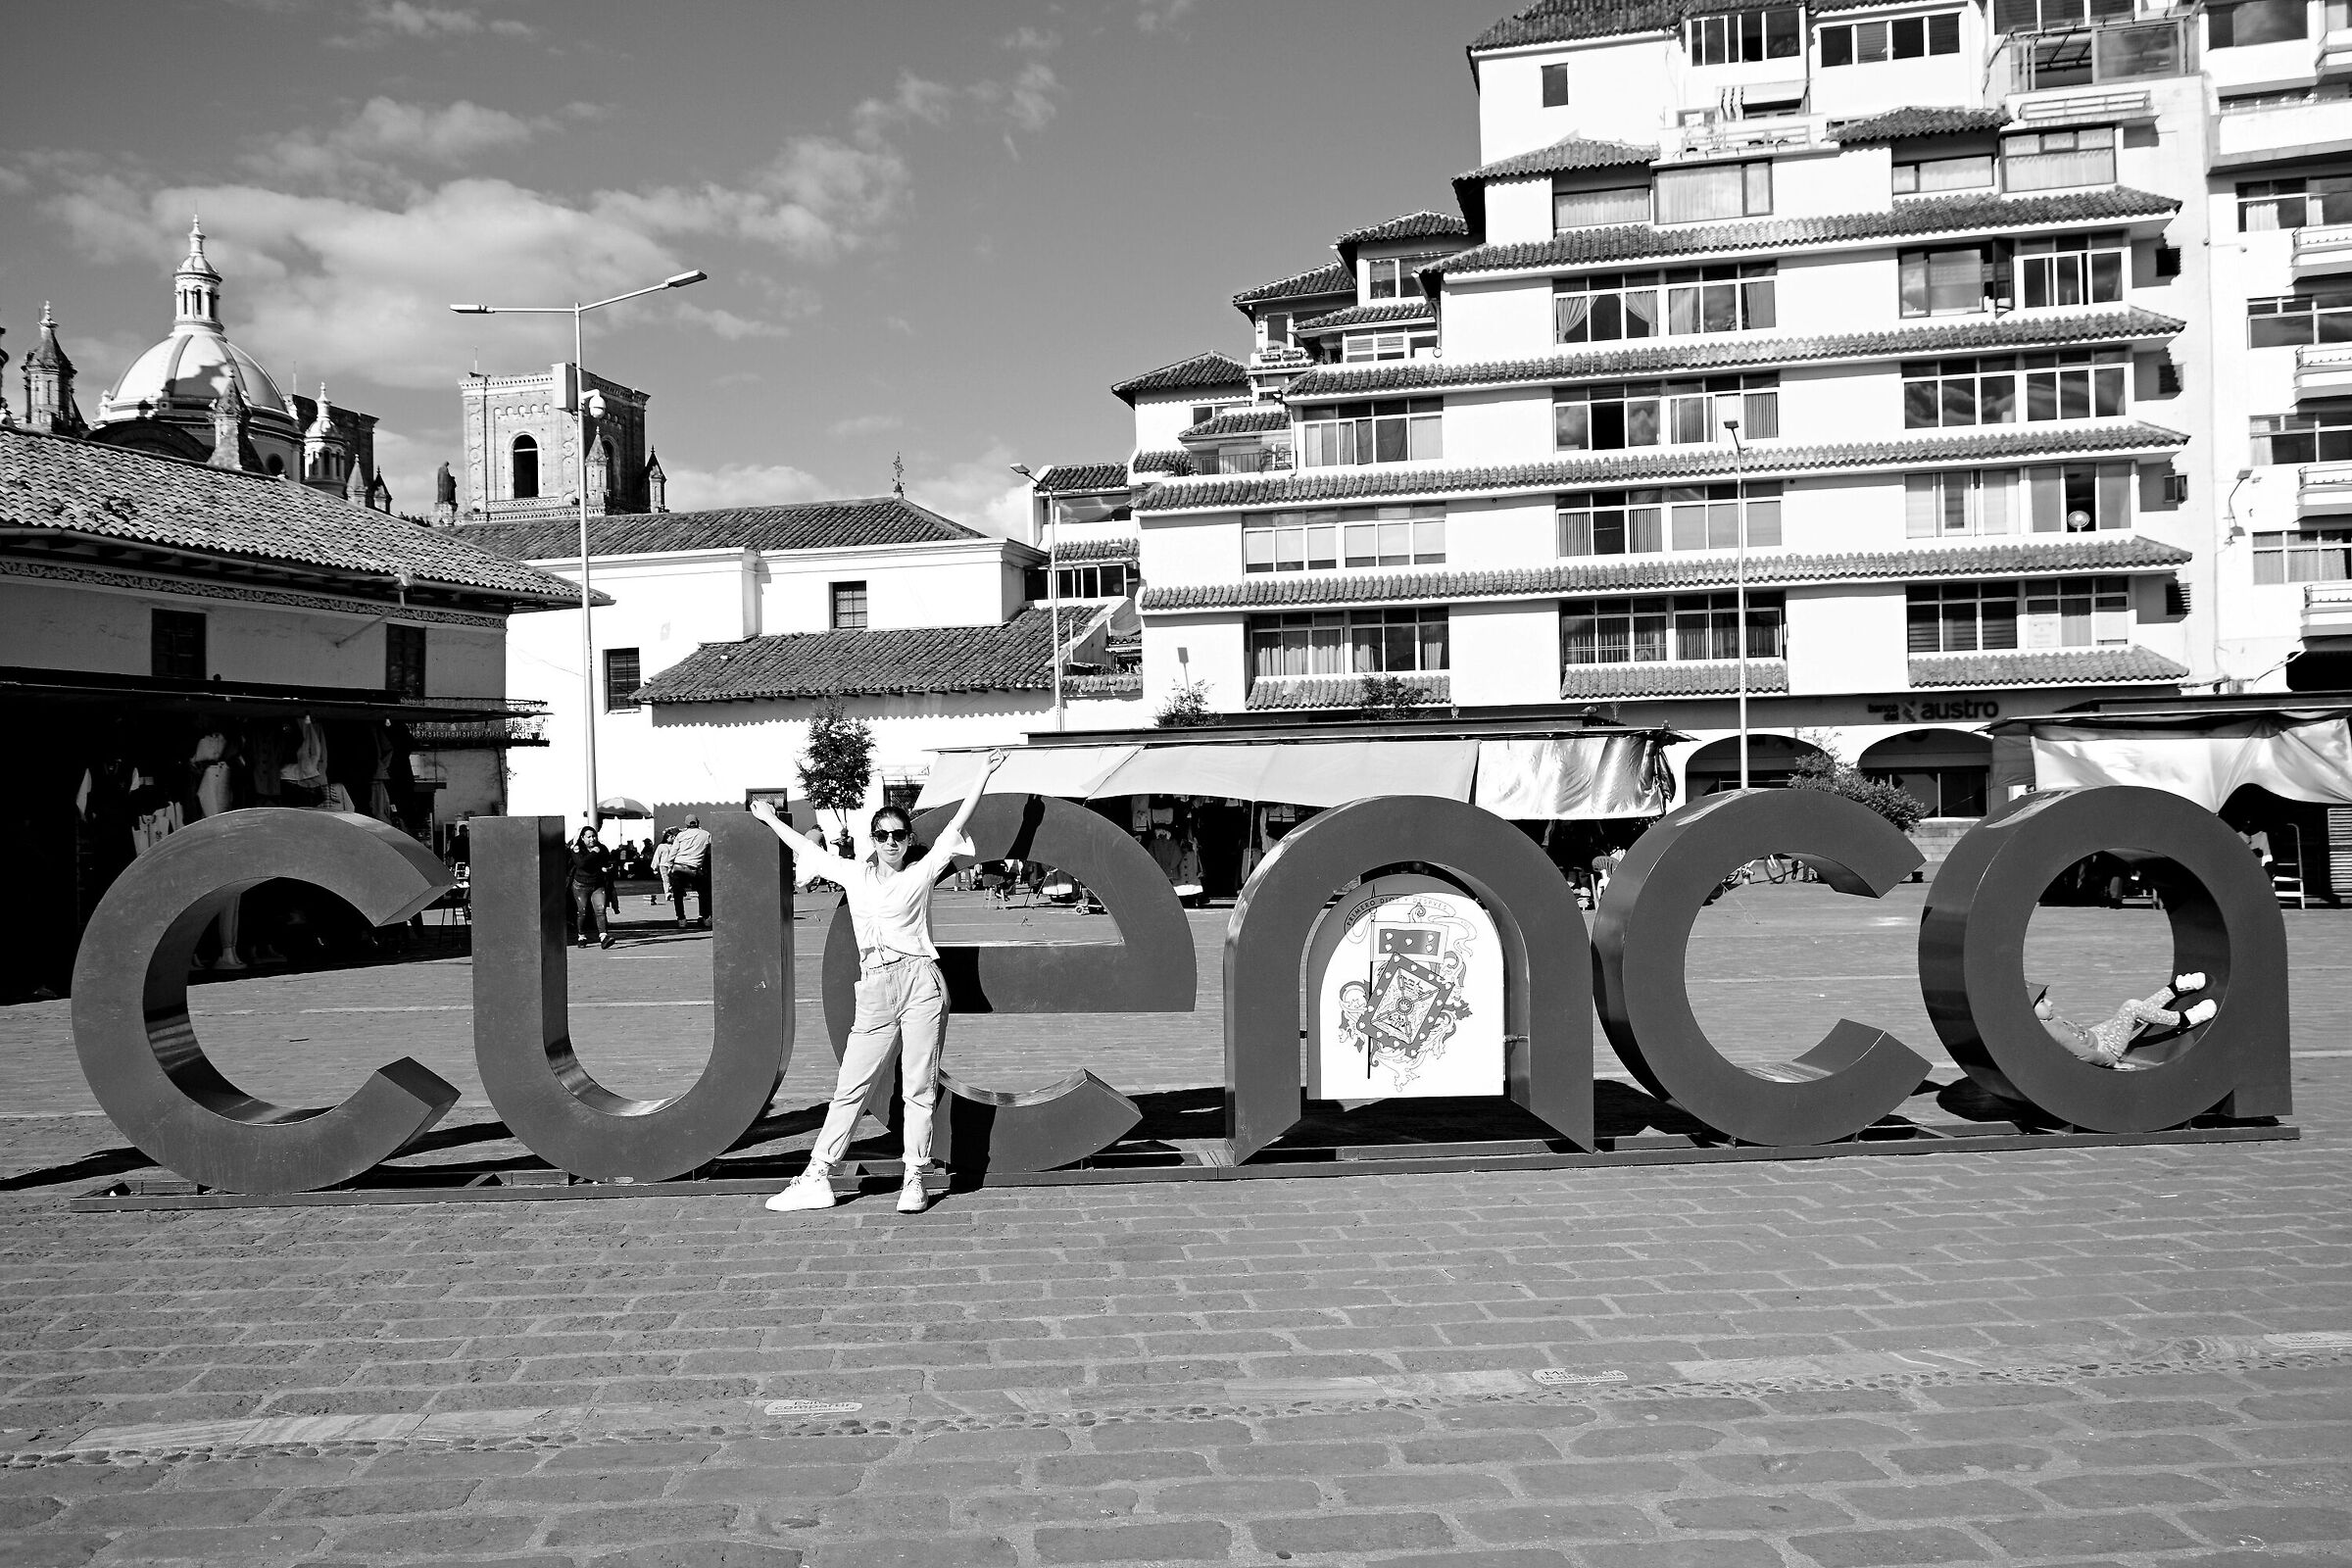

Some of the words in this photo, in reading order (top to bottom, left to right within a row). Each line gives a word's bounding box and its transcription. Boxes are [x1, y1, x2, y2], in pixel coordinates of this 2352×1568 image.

[1921, 699, 1999, 720] austro
[1347, 900, 1376, 927] PRIMERO
[71, 785, 2293, 1196] cuenca
